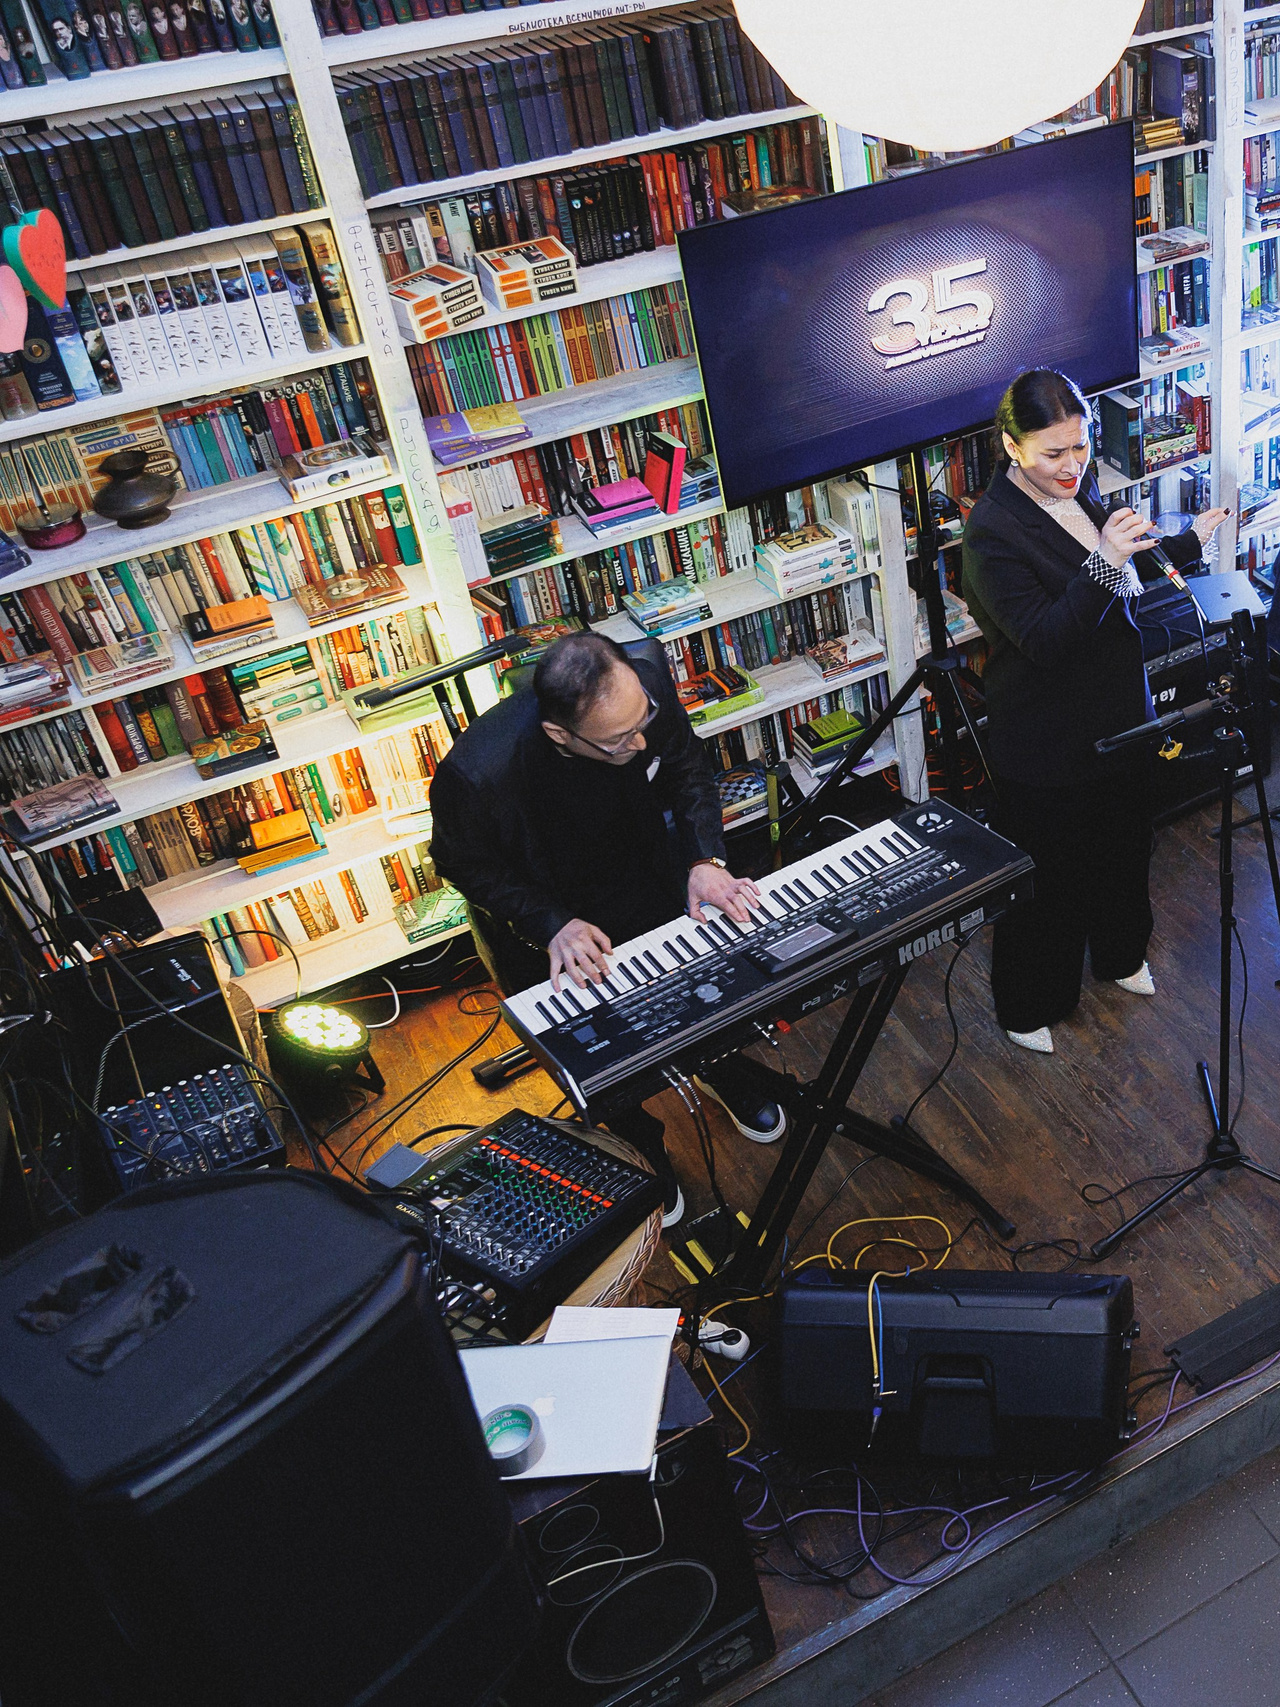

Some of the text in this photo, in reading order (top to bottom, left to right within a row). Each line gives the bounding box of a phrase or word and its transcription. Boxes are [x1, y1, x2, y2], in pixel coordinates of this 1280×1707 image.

[508, 1, 646, 33] БИБЛИОТЕКА ВСЕМИРНОЙ ЛИТ-РЫ
[428, 210, 441, 228] КИНГ
[447, 201, 460, 219] КИНГ
[383, 232, 397, 252] КИНГ
[402, 227, 415, 248] КИНГ
[534, 264, 555, 275] СТИВЕН
[347, 224, 394, 359] ФАНТАСТИКА
[540, 286, 560, 298] СТИВЕН
[454, 312, 471, 325] СТИВЕН
[867, 258, 994, 354] 35
[335, 362, 353, 403] ТРУГАЦКИЕ
[89, 434, 136, 452] МАКС ФРАЙ
[688, 429, 700, 446] НЕТ
[401, 416, 443, 537] РУССКАЯ
[469, 471, 482, 490] Лавр
[673, 528, 699, 581] МАКАНИН
[38, 606, 63, 641] АКСЕНОВ
[173, 697, 193, 722] ЗЕМЛЯ
[441, 700, 458, 729] Millennium
[123, 721, 145, 754] ЕФРЕМОВ
[898, 921, 955, 967] KORG
